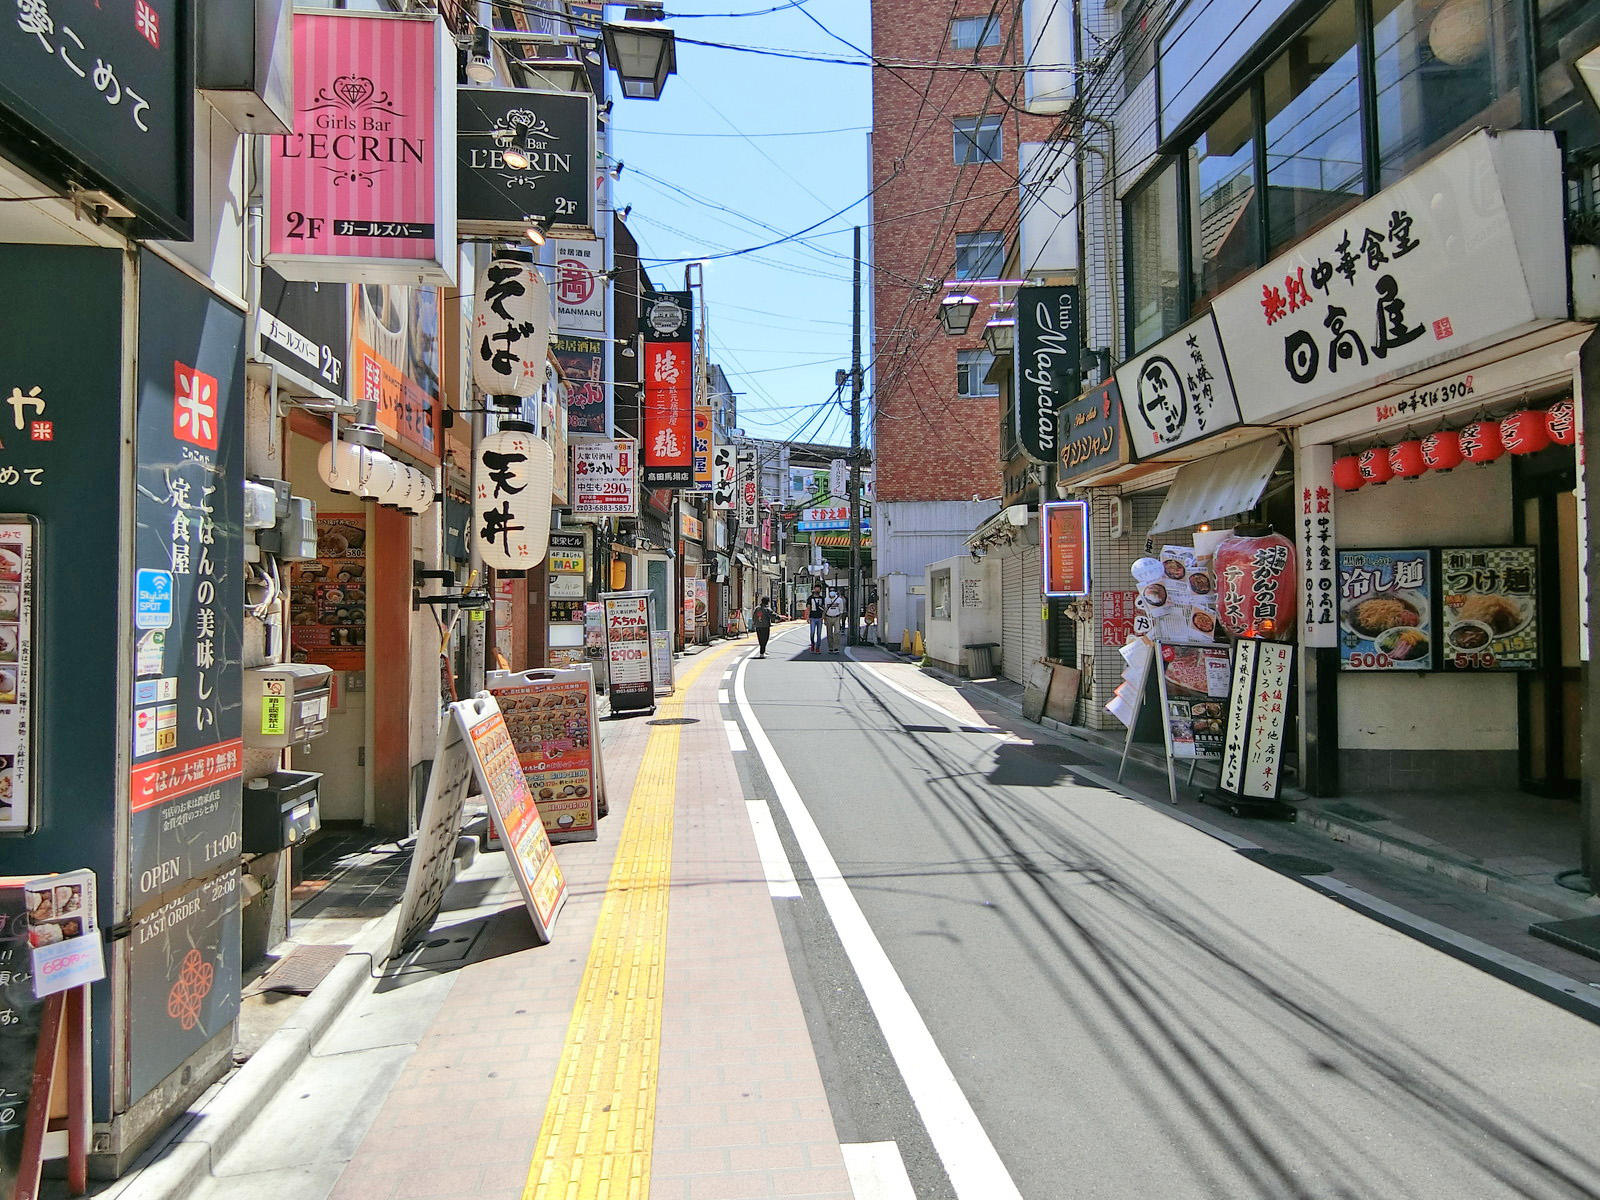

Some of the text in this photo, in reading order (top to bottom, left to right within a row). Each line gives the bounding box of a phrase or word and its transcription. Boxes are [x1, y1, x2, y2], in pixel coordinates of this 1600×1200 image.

[316, 114, 391, 132] Girls Bar
[280, 133, 425, 165] L'ECRIN
[527, 138, 547, 150] Bar
[470, 149, 572, 173] L'ERIN
[555, 197, 577, 215] 2F
[286, 211, 325, 239] 2F
[340, 221, 422, 237] ガールズバー
[1261, 210, 1420, 326] 熱烈中華食堂
[481, 265, 535, 376] そば
[557, 307, 602, 318] MANMARU
[1058, 294, 1073, 330] Club
[270, 320, 317, 359] ガールズバー
[1284, 274, 1427, 384] 日高屋
[320, 345, 342, 385] 2F
[1025, 301, 1068, 451] Magician
[6, 386, 46, 430] や
[178, 373, 215, 441] 米
[1145, 365, 1180, 434] ふたご
[1186, 373, 1207, 432] ホルモン
[33, 422, 51, 439] 米
[653, 427, 682, 458] 龍
[576, 460, 614, 476] 大ちゃん
[577, 452, 613, 460] 大衆居酒屋
[577, 482, 632, 494] 中生も 290円
[647, 472, 690, 482] 高田馬場店
[715, 448, 735, 506] らーめん
[480, 450, 529, 558] 天丼
[583, 504, 632, 512] 03-6883-5857
[171, 477, 191, 575] 定食屋
[551, 536, 582, 546] 東栄ビル
[553, 560, 580, 569] MAP
[1316, 485, 1335, 625] 熱烈中華食堂 日高屋
[1341, 558, 1424, 599] 冷し麺
[1446, 566, 1533, 595] つけ麺
[138, 601, 162, 611] SPOT
[139, 591, 170, 601] SkyLink
[197, 484, 216, 731] ごはんの美味しい
[1223, 565, 1248, 634] テールスープ
[609, 615, 646, 628] 大ちゃん
[611, 649, 642, 661] 290円
[1349, 653, 1394, 668] 500円
[267, 697, 280, 729] 路上喫煙禁止
[1252, 646, 1274, 764] いろいろ食べやすく!!
[1261, 649, 1286, 792] 目方も値段も他店の半分
[158, 732, 175, 746] iD
[142, 748, 238, 796] ごはん大盛り無料
[140, 856, 182, 893] OPEN
[204, 831, 238, 862] 11:00
[140, 915, 167, 945] LAST
[167, 897, 202, 930] ORDER
[211, 878, 236, 903] 22:00
